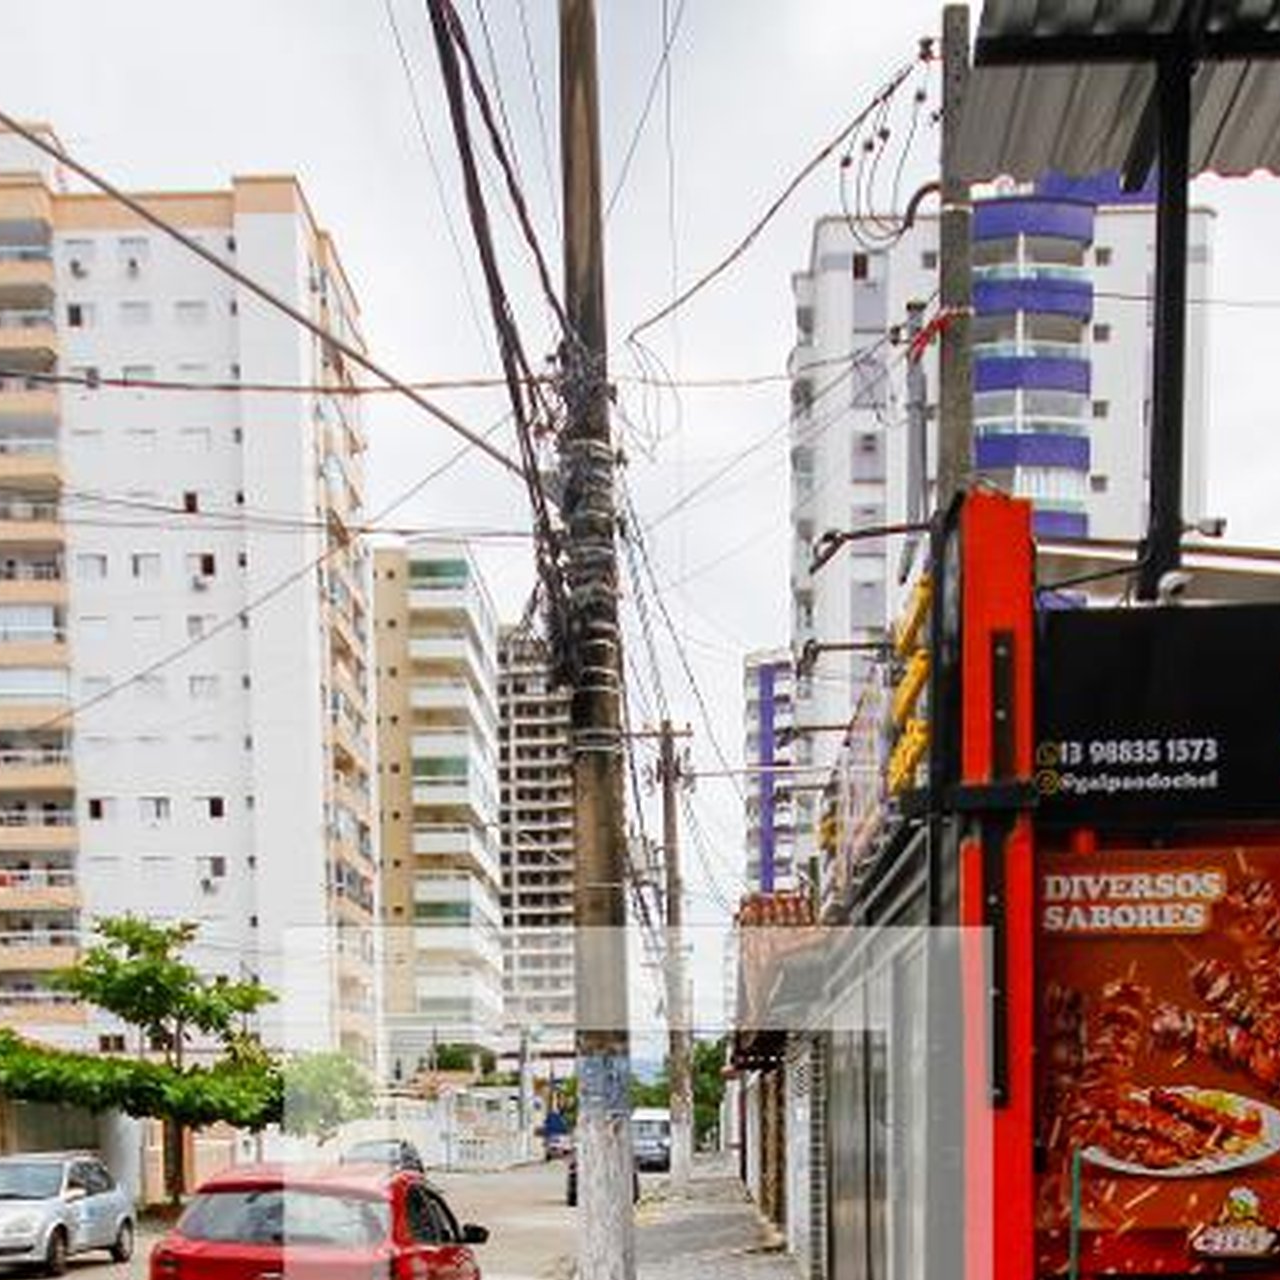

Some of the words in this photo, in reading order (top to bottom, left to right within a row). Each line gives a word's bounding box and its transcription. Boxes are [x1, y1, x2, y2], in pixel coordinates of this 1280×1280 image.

[1166, 736, 1218, 763] 1573
[1044, 872, 1225, 900] DIVERSOS
[1043, 904, 1205, 931] SABORES
